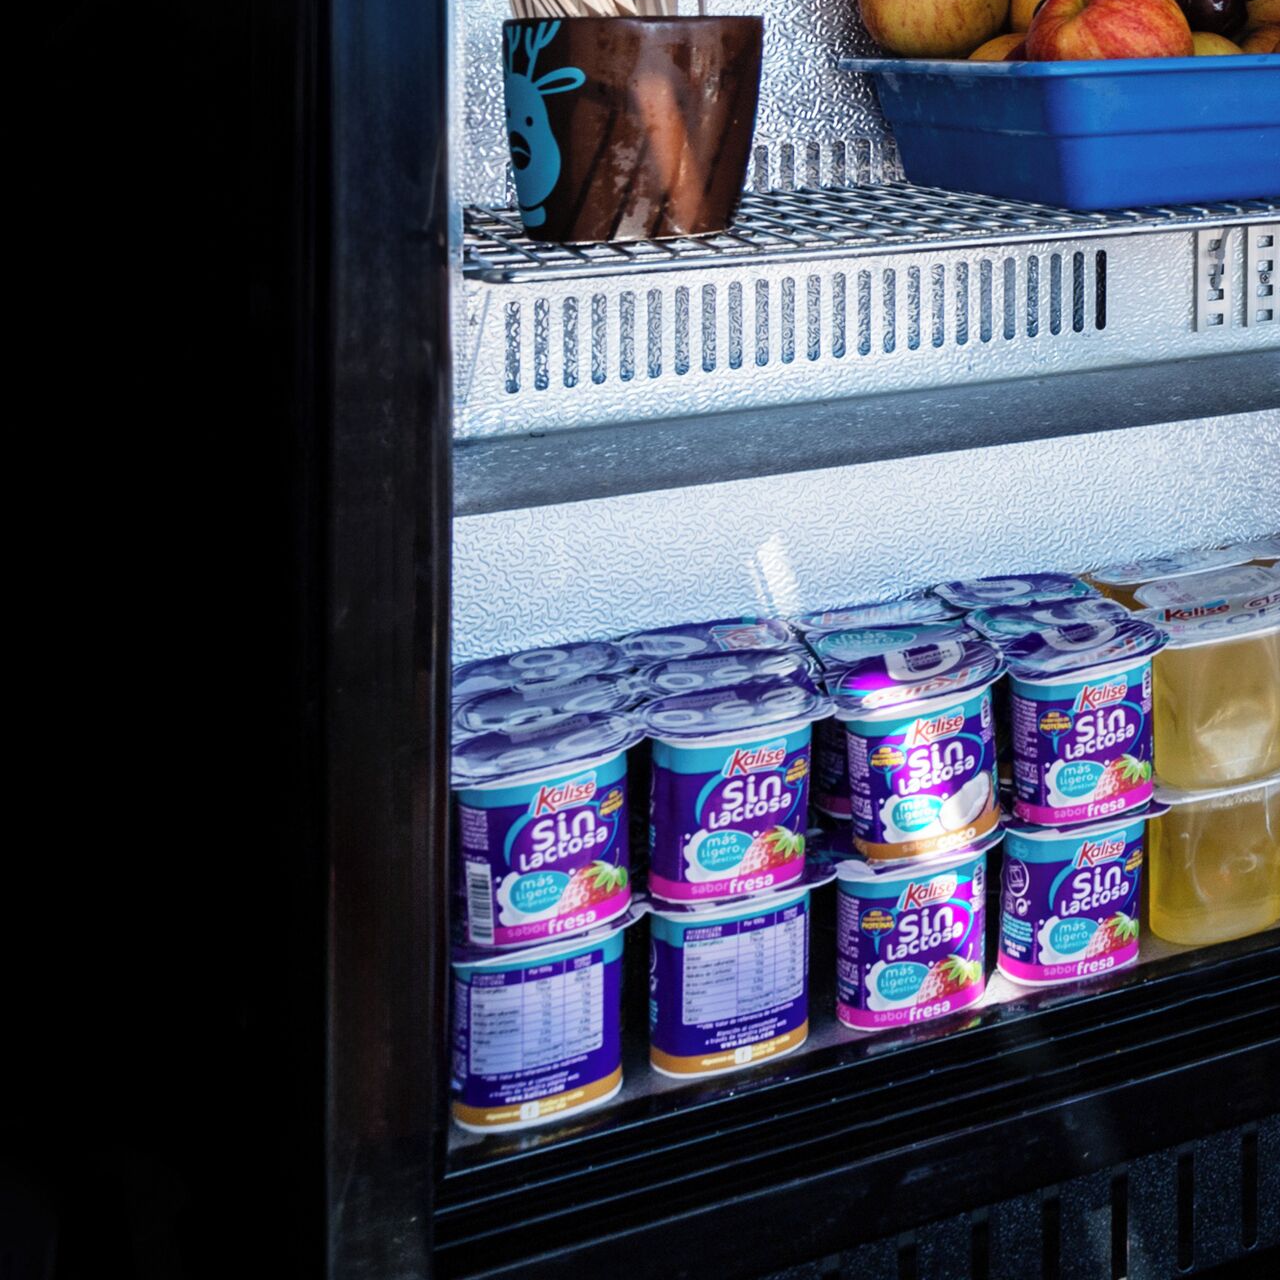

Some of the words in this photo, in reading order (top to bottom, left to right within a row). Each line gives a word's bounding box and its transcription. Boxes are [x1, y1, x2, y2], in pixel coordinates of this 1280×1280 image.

[1165, 604, 1229, 622] Kalise
[1080, 684, 1127, 711] Kalise
[913, 715, 963, 745] Kalise
[1076, 709, 1125, 743] Sin
[728, 748, 785, 777] Kalise
[908, 741, 964, 777] Sin
[535, 782, 595, 816] Kalise
[722, 775, 782, 811] Sin
[1087, 798, 1125, 816] fresa
[532, 810, 595, 851] Sin
[1077, 840, 1124, 867] Kalise
[729, 873, 774, 893] fresa
[904, 883, 955, 910] Kalise
[1073, 866, 1121, 899] Sin
[548, 910, 597, 934] fresa
[899, 907, 953, 942] Sin
[1077, 956, 1114, 975] fresa
[909, 1001, 950, 1021] fresa
